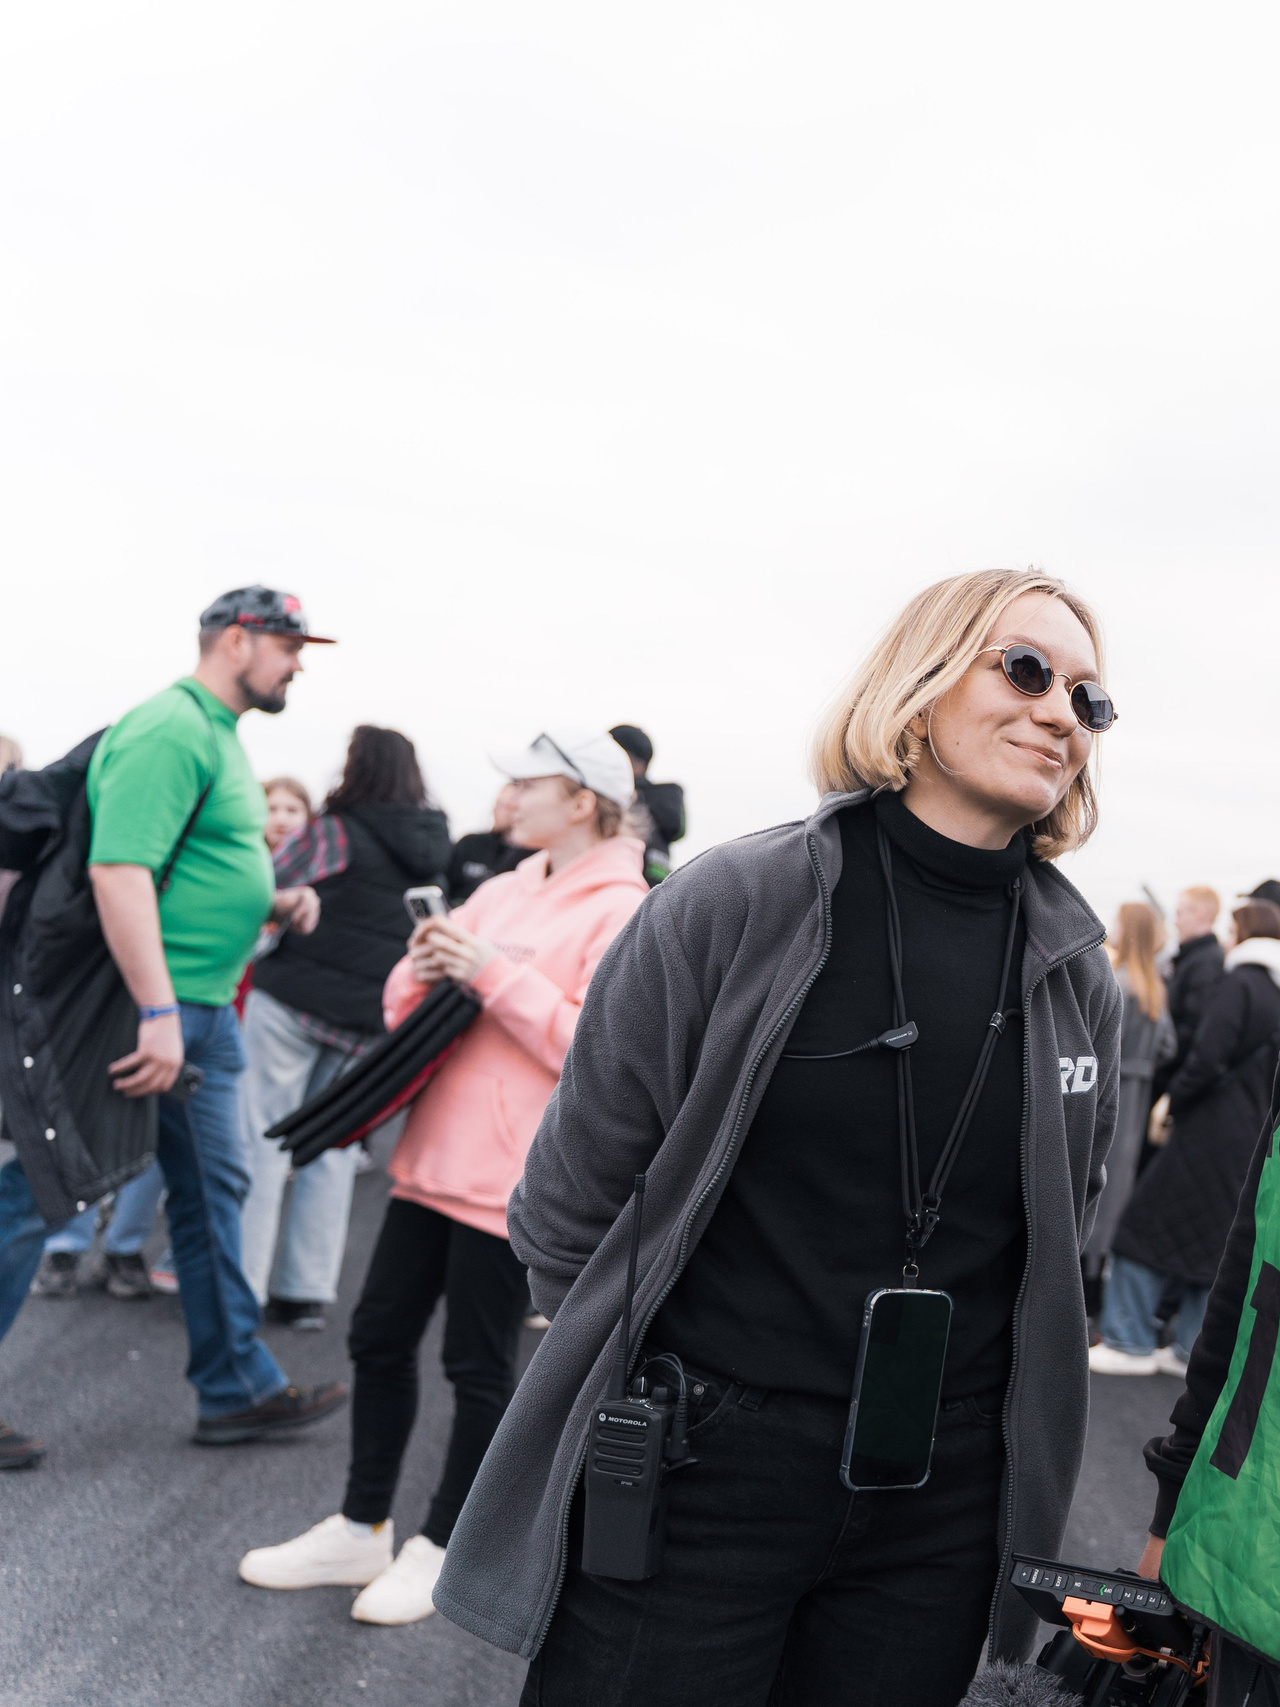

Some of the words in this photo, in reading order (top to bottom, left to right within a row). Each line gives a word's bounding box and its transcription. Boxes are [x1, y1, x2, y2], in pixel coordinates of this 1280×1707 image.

[607, 1416, 647, 1427] MOTOROLA
[1031, 1568, 1040, 1583] MENU
[1055, 1575, 1063, 1587] EXIT
